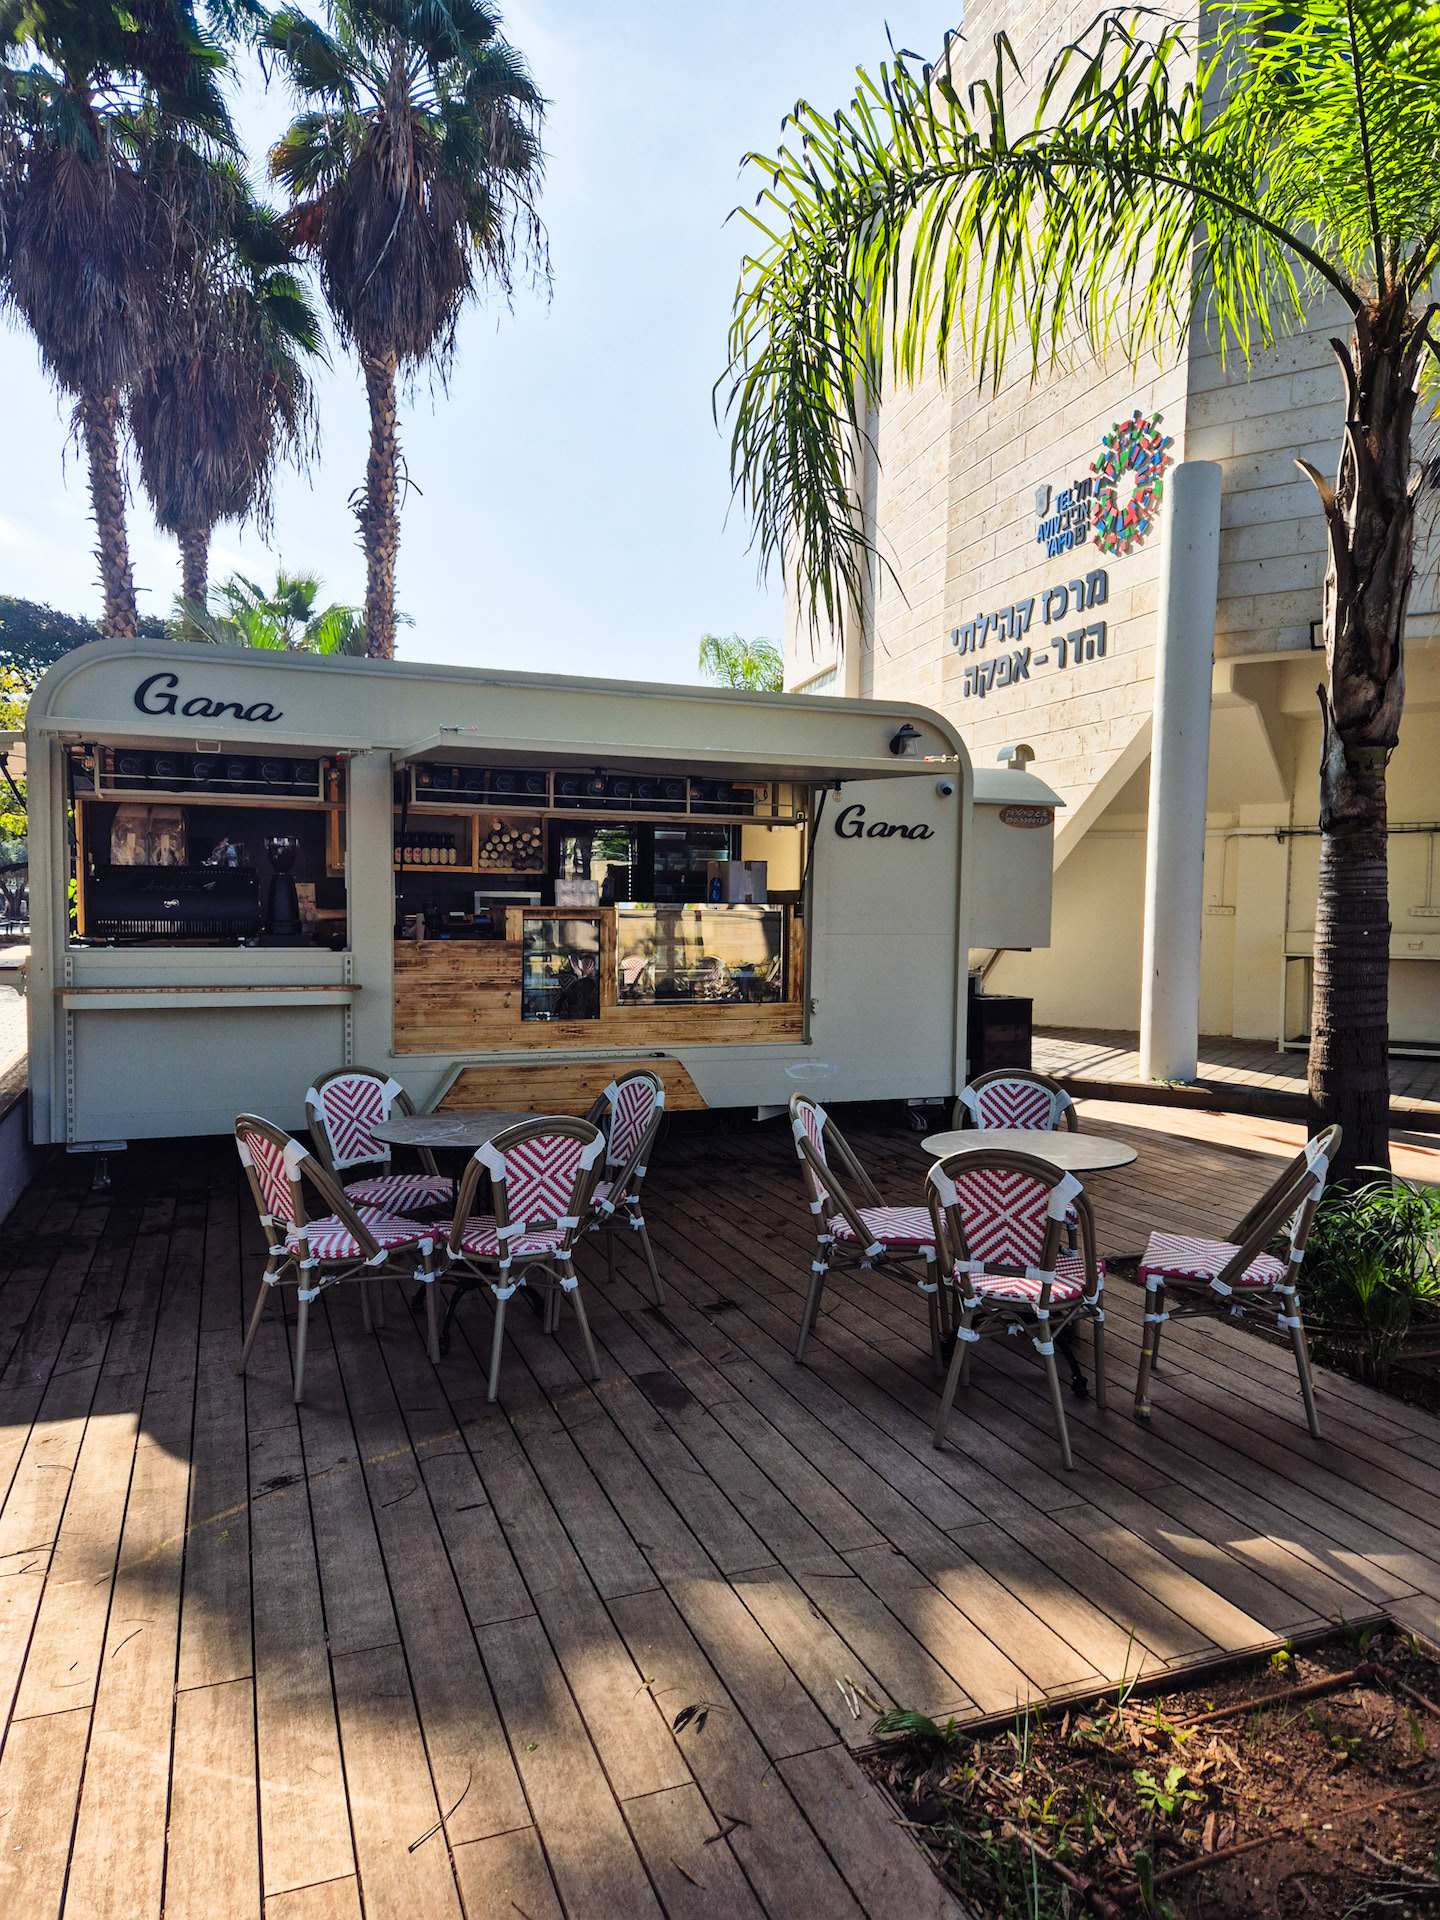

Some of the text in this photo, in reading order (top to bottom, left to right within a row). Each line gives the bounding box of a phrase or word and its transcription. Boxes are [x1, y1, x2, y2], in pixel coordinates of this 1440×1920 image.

[1055, 488, 1074, 513] TEL
[1074, 477, 1092, 502] תל
[1036, 514, 1062, 543] AVIV
[1061, 500, 1091, 531] אביב
[1045, 530, 1073, 558] YAFO
[1073, 521, 1091, 546] יפו
[951, 568, 1109, 655] מרכז קהילתי
[133, 672, 284, 723] Gana
[834, 804, 935, 840] Gana
